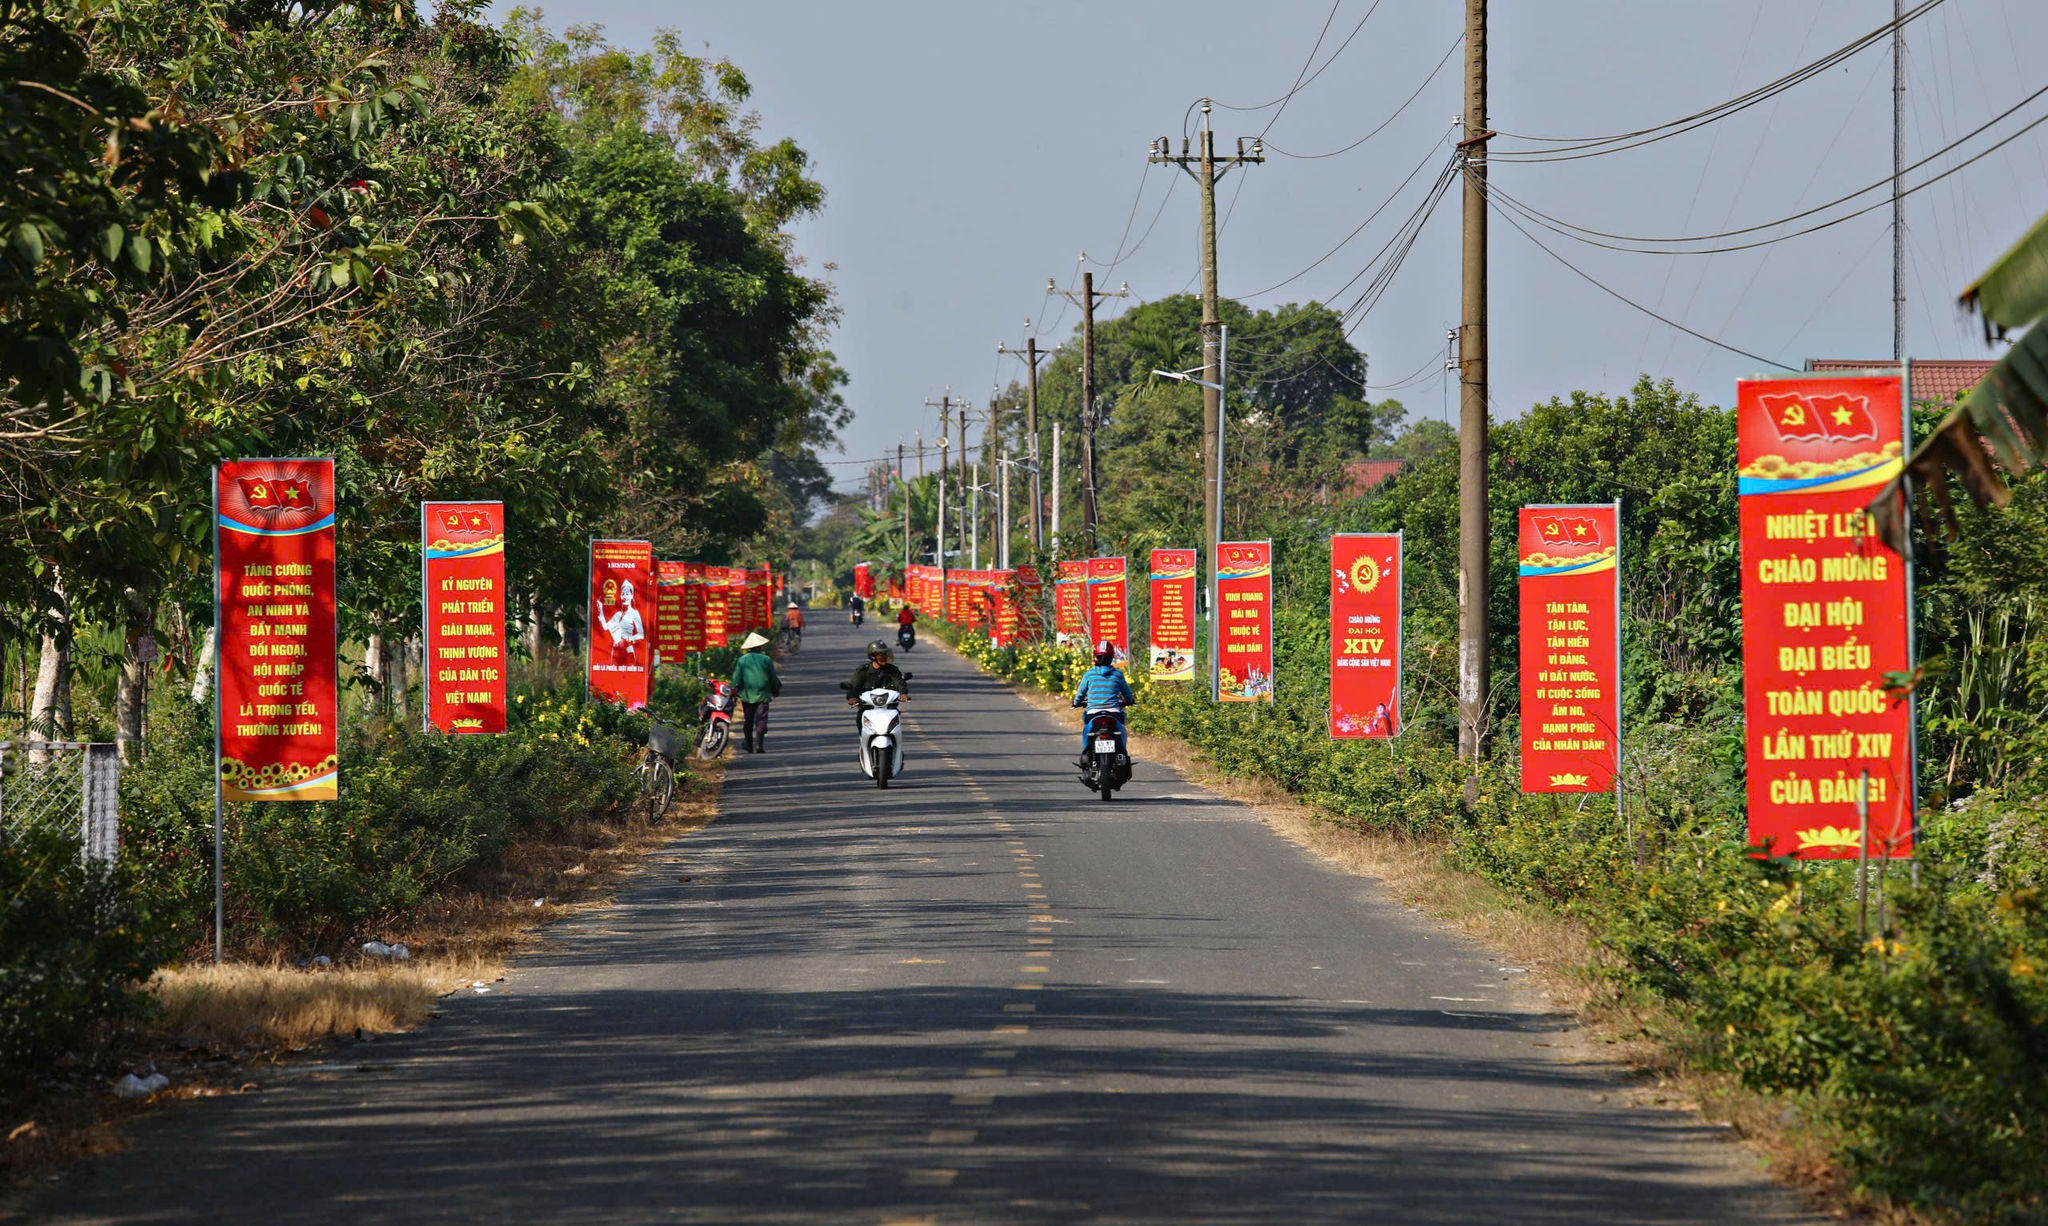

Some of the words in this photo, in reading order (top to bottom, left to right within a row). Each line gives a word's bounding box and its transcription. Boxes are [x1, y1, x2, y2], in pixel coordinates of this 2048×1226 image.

[1766, 509, 1828, 544] NHIỆT
[244, 564, 272, 576] TĂNG
[275, 562, 312, 576] CƯỜNG
[1758, 554, 1816, 583] CHÀO
[1822, 553, 1887, 582] MỪNG
[242, 582, 271, 598] QUỐC
[274, 582, 314, 596] PHÒNG,
[442, 577, 454, 591] KỶ
[456, 577, 493, 591] NGUYÊN
[247, 605, 263, 616] AN
[265, 604, 293, 616] NINH
[295, 603, 310, 616] VÀ
[441, 600, 466, 613] PHÁT
[467, 597, 494, 613] TRIỂN
[1546, 602, 1564, 615] TẬN
[1566, 602, 1589, 614] TÂM,
[1784, 603, 1821, 632] ĐẠI
[1827, 596, 1863, 631] HỘI
[249, 622, 272, 636] ĐẨY
[274, 624, 307, 638] MẠNH
[441, 623, 463, 636] GIÀU
[465, 624, 495, 638] MẠNH,
[1547, 619, 1566, 632] TẬN
[1568, 620, 1588, 632] LỰC,
[1344, 639, 1384, 654] XIV
[1547, 636, 1565, 649] TẬN
[1567, 635, 1589, 647] HIẾN
[249, 642, 269, 656] ĐỐI
[270, 644, 307, 658] NGOẠI,
[438, 647, 465, 661] THỊNH
[467, 646, 498, 660] VƯỢNG
[1779, 647, 1816, 677] ĐẠI
[1821, 636, 1871, 670] BIỂU
[1548, 653, 1557, 664] VÌ
[1559, 653, 1588, 665] ĐẢNG,
[253, 662, 272, 678] HỘI
[274, 662, 304, 677] NHẬP
[439, 667, 458, 681] CỦA
[459, 668, 479, 681] DÂN
[480, 667, 498, 683] TỘC
[1539, 670, 1548, 681] VÌ
[1550, 670, 1568, 681] ĐẤT
[1570, 670, 1598, 682] NƯỚC,
[258, 682, 287, 697] QUỐC
[290, 681, 304, 695] TẾ
[1536, 688, 1545, 698] VÌ
[1548, 687, 1573, 700] CUỘC
[1575, 687, 1600, 699] SỐNG
[445, 690, 465, 706] VIỆT
[467, 692, 492, 703] NAM!
[1766, 686, 1823, 716] TOÀN
[1829, 680, 1887, 717] QUỐC
[240, 703, 254, 716] LÀ
[255, 704, 292, 718] TRỌNG
[295, 702, 319, 716] YẾU,
[1552, 704, 1567, 716] ẤM
[1569, 706, 1585, 716] NO,
[236, 722, 279, 736] THƯỜNG
[283, 721, 322, 735] XUYÊN!
[1543, 723, 1568, 734] HẠNH
[1570, 722, 1595, 733] PHÚC
[1533, 738, 1552, 750] CỦA
[1554, 739, 1580, 750] NHÂN
[1582, 739, 1605, 750] DÂN!
[1763, 727, 1806, 760] LẦN
[1810, 729, 1854, 759] THỨ
[1857, 733, 1892, 758] XIV
[1770, 771, 1814, 804] CỦA
[1818, 770, 1887, 803] ĐẢNG!
